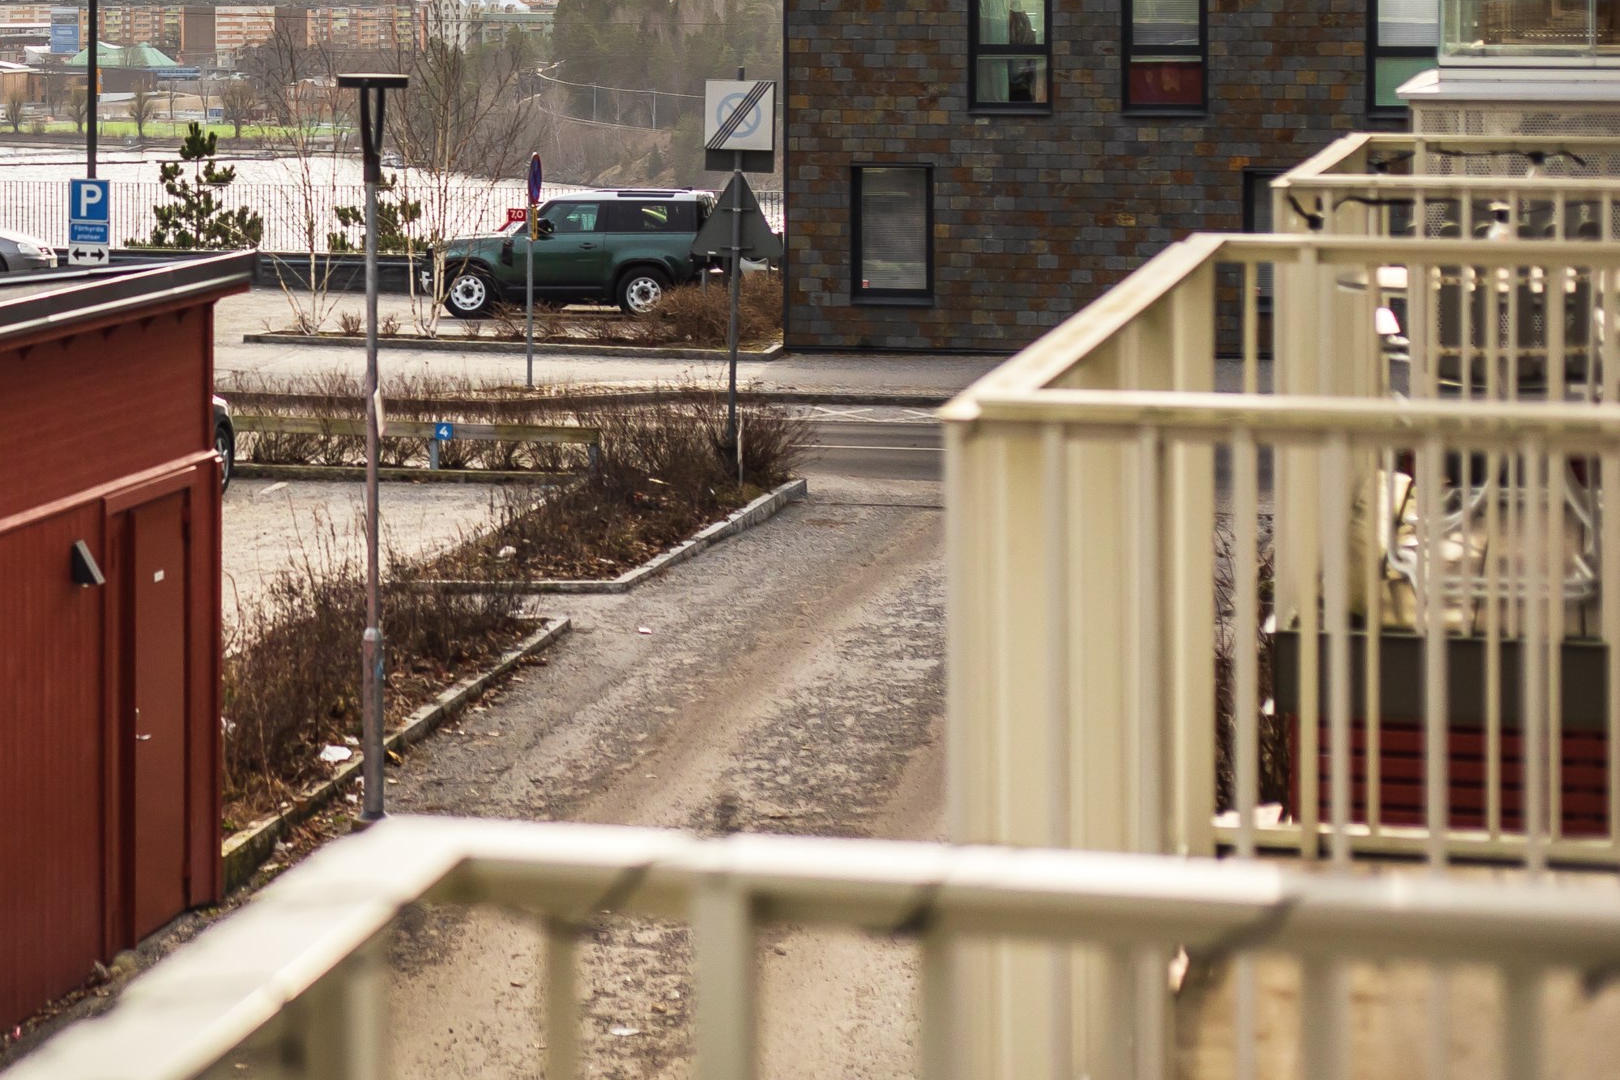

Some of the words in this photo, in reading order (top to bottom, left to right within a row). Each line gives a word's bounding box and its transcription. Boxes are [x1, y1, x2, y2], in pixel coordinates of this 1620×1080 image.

[80, 183, 103, 217] P
[510, 210, 524, 220] 7,0
[439, 425, 449, 438] 4
